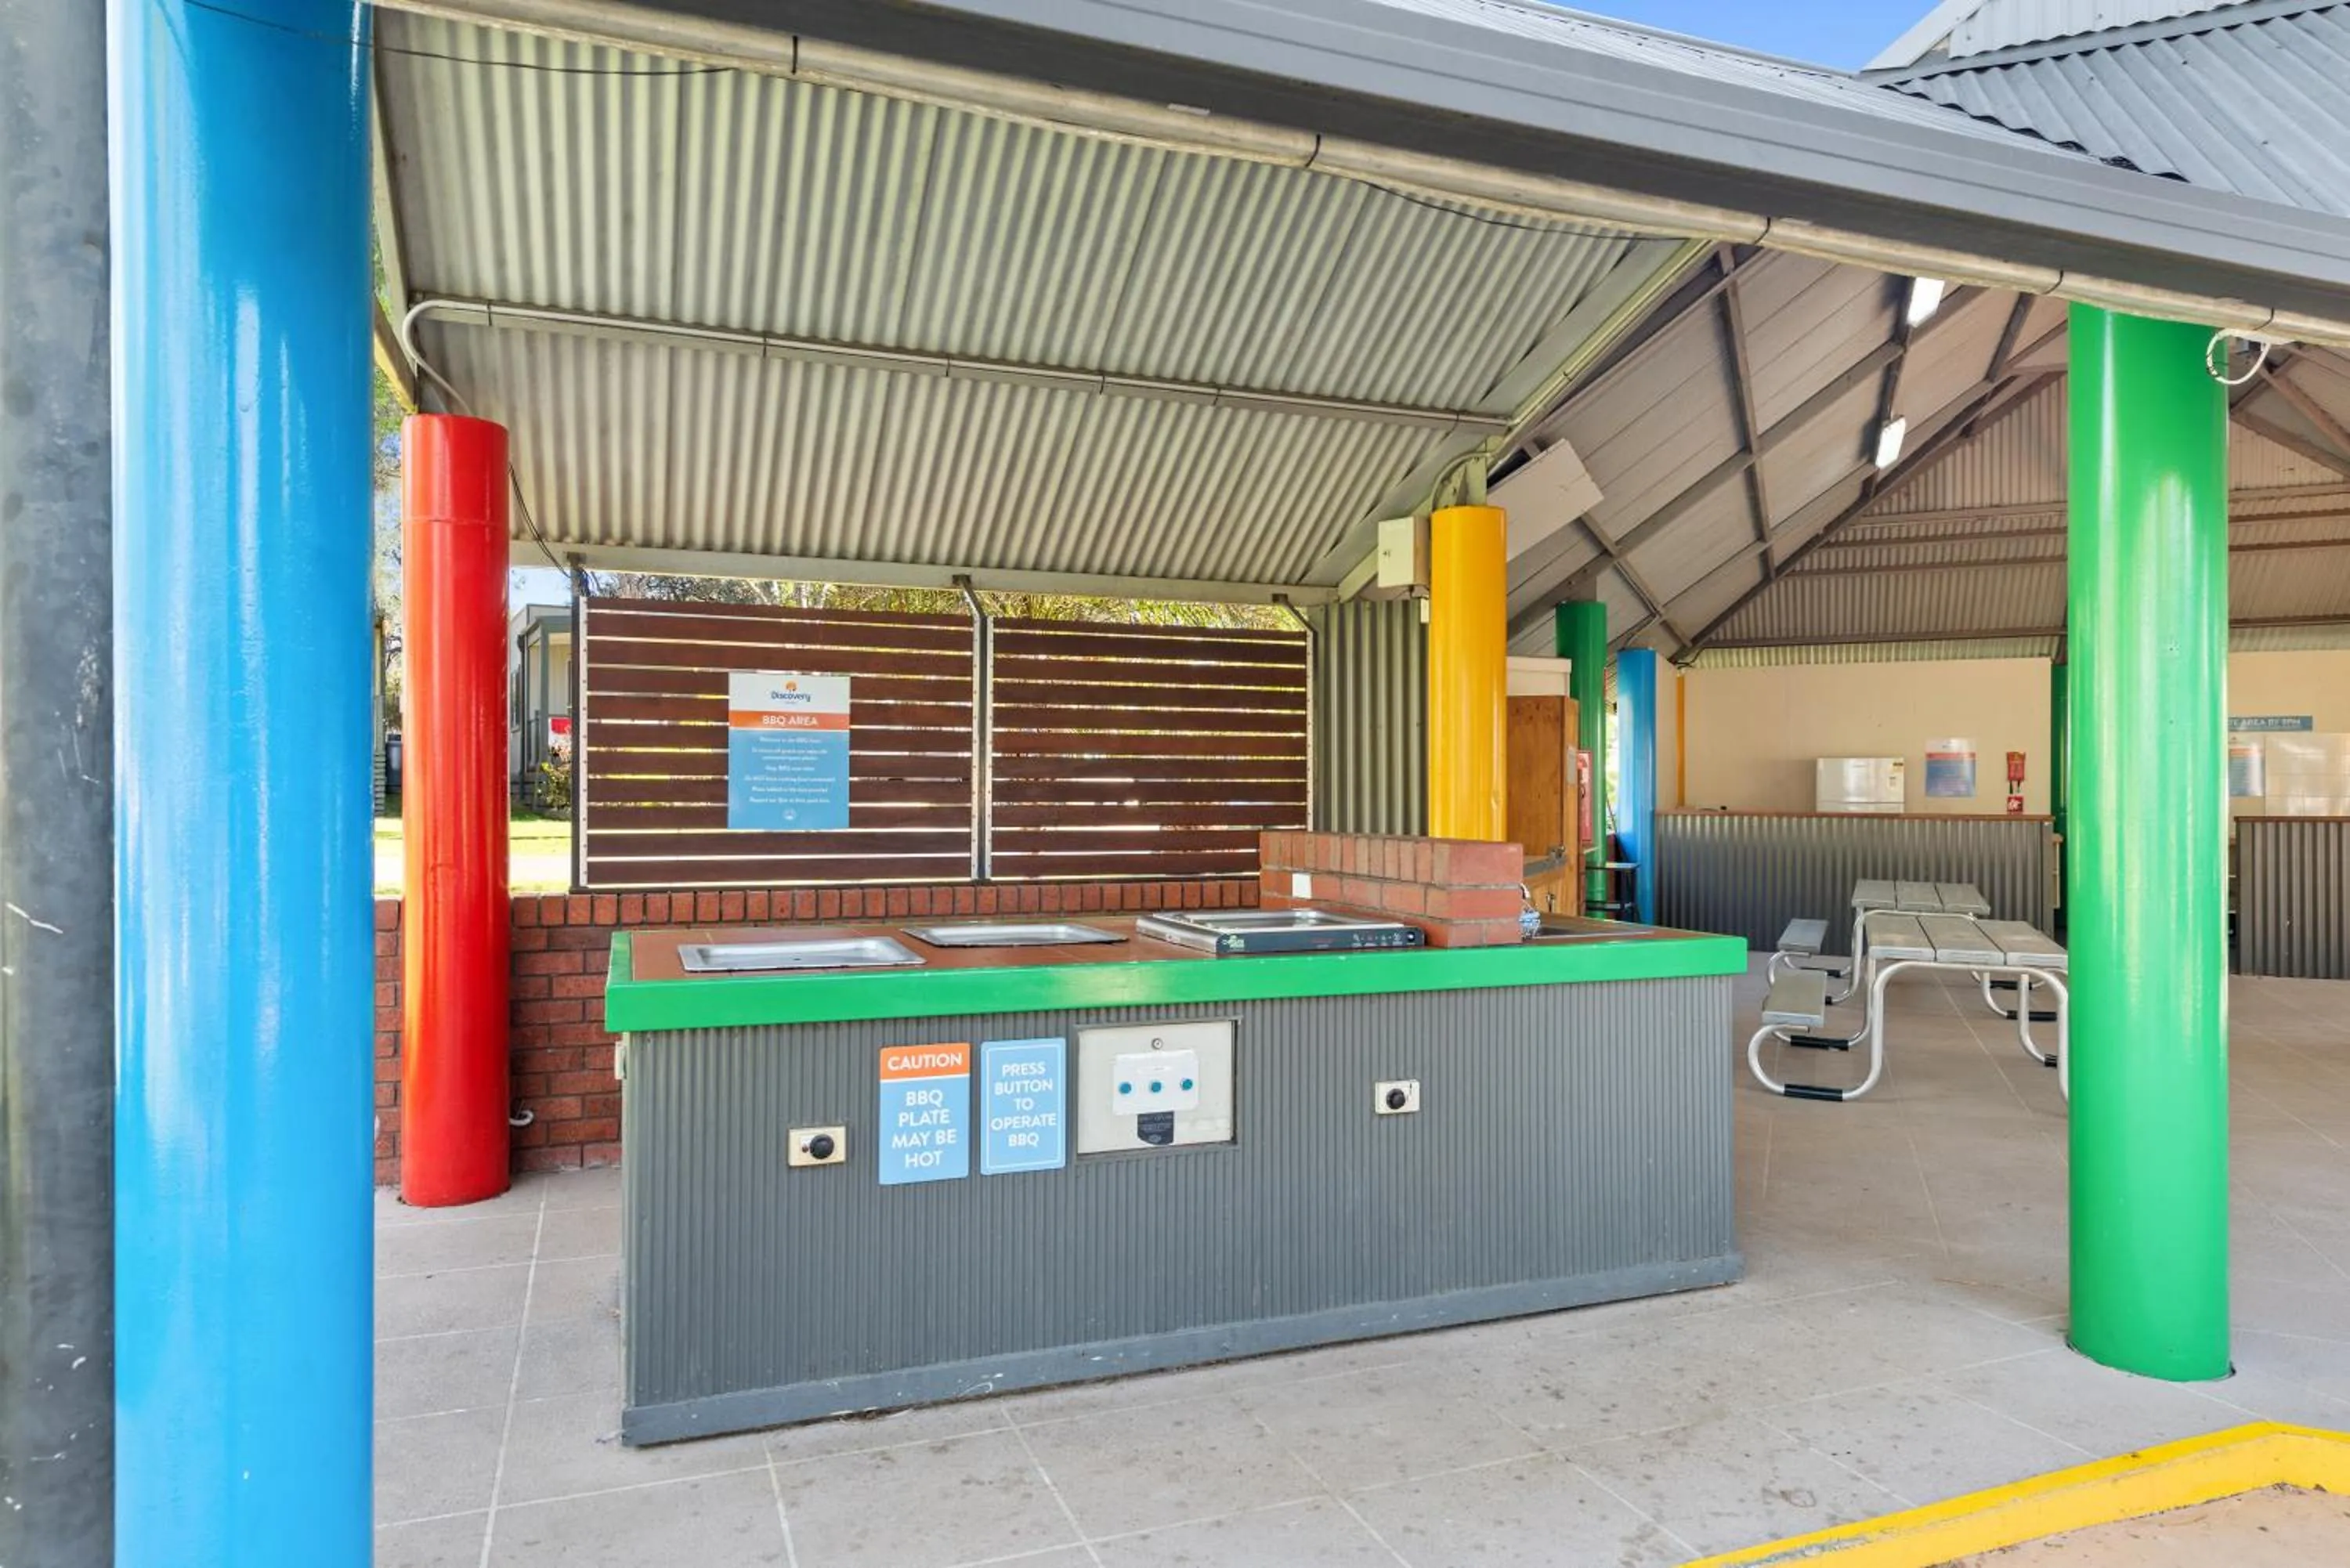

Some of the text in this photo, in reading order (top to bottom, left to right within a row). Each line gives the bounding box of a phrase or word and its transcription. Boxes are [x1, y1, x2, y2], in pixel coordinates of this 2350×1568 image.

[771, 691, 811, 703] Discovery
[763, 715, 819, 727] BBQ AREA
[888, 1053, 963, 1071] CAUTION
[1002, 1061, 1047, 1076] PRESS
[994, 1078, 1053, 1095] BUTTON
[906, 1089, 943, 1107] BBQ
[1014, 1097, 1034, 1111] TO
[898, 1108, 950, 1127] PLATE
[991, 1113, 1057, 1131] OPERATE
[891, 1129, 957, 1148] MAY BE
[1008, 1132, 1039, 1147] BBQ
[905, 1151, 943, 1168] HOT
